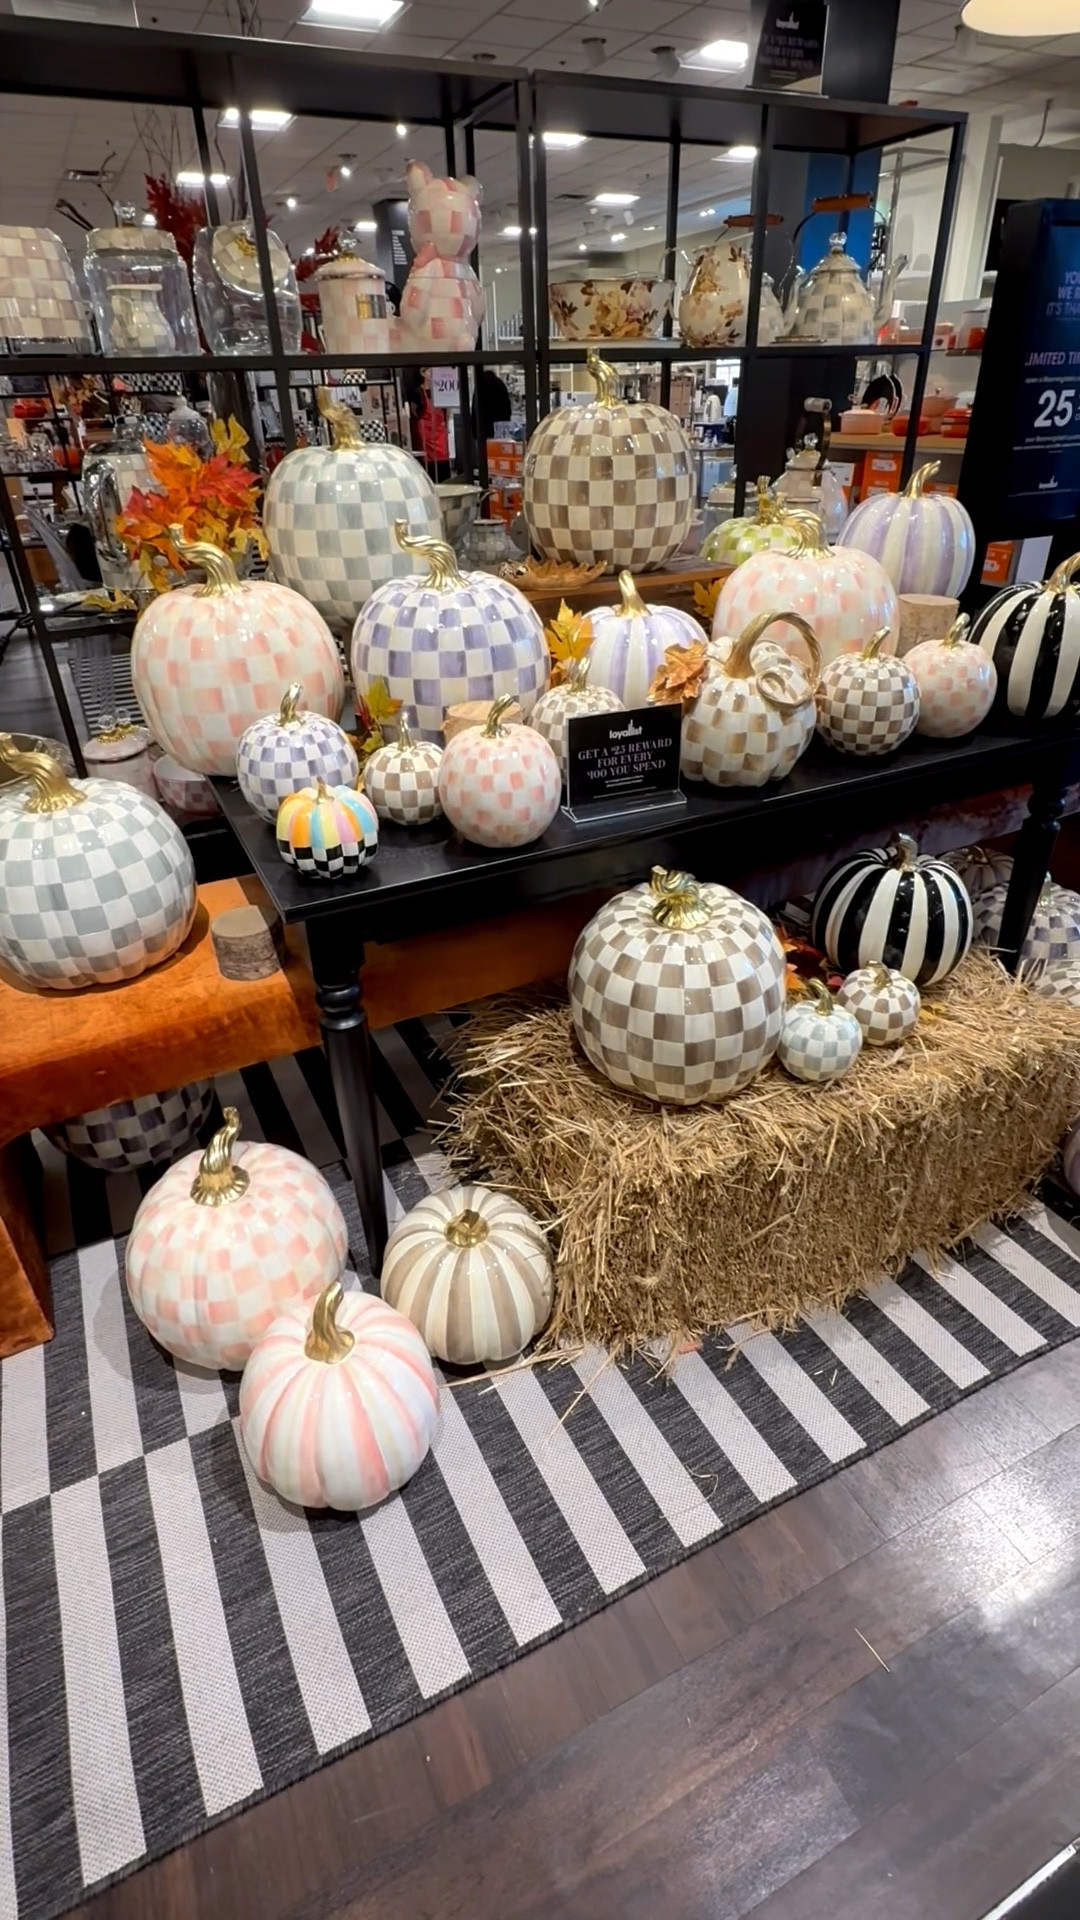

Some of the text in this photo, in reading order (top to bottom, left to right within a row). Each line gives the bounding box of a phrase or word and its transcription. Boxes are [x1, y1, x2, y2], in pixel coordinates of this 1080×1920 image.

[1034, 389, 1076, 428] 25
[578, 738, 672, 760] GET A $25 REWARD
[597, 751, 653, 768] FOR EVERY
[610, 765, 630, 776] YOU
[633, 760, 666, 773] SPEND
